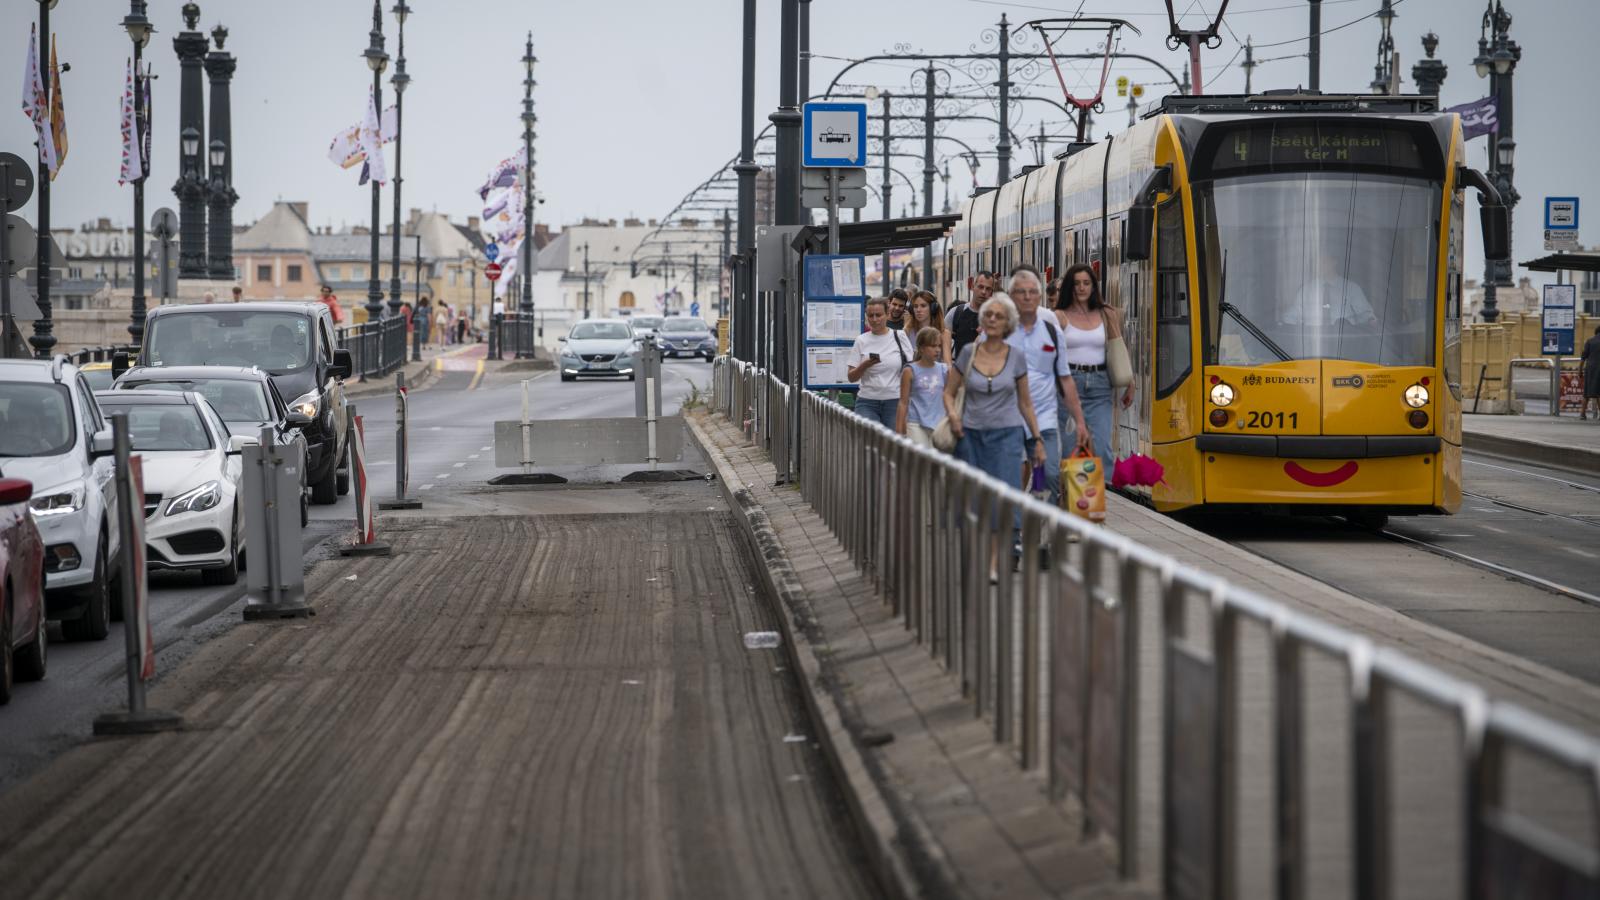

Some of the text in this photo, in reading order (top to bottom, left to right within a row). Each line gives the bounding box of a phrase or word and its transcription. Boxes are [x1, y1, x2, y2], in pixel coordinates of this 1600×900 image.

[1271, 134, 1381, 147] Széll Kálmán
[1234, 135, 1247, 161] 4
[1304, 147, 1348, 160] tér M
[1265, 375, 1316, 385] BUDAPEST
[1247, 411, 1299, 429] 2011
